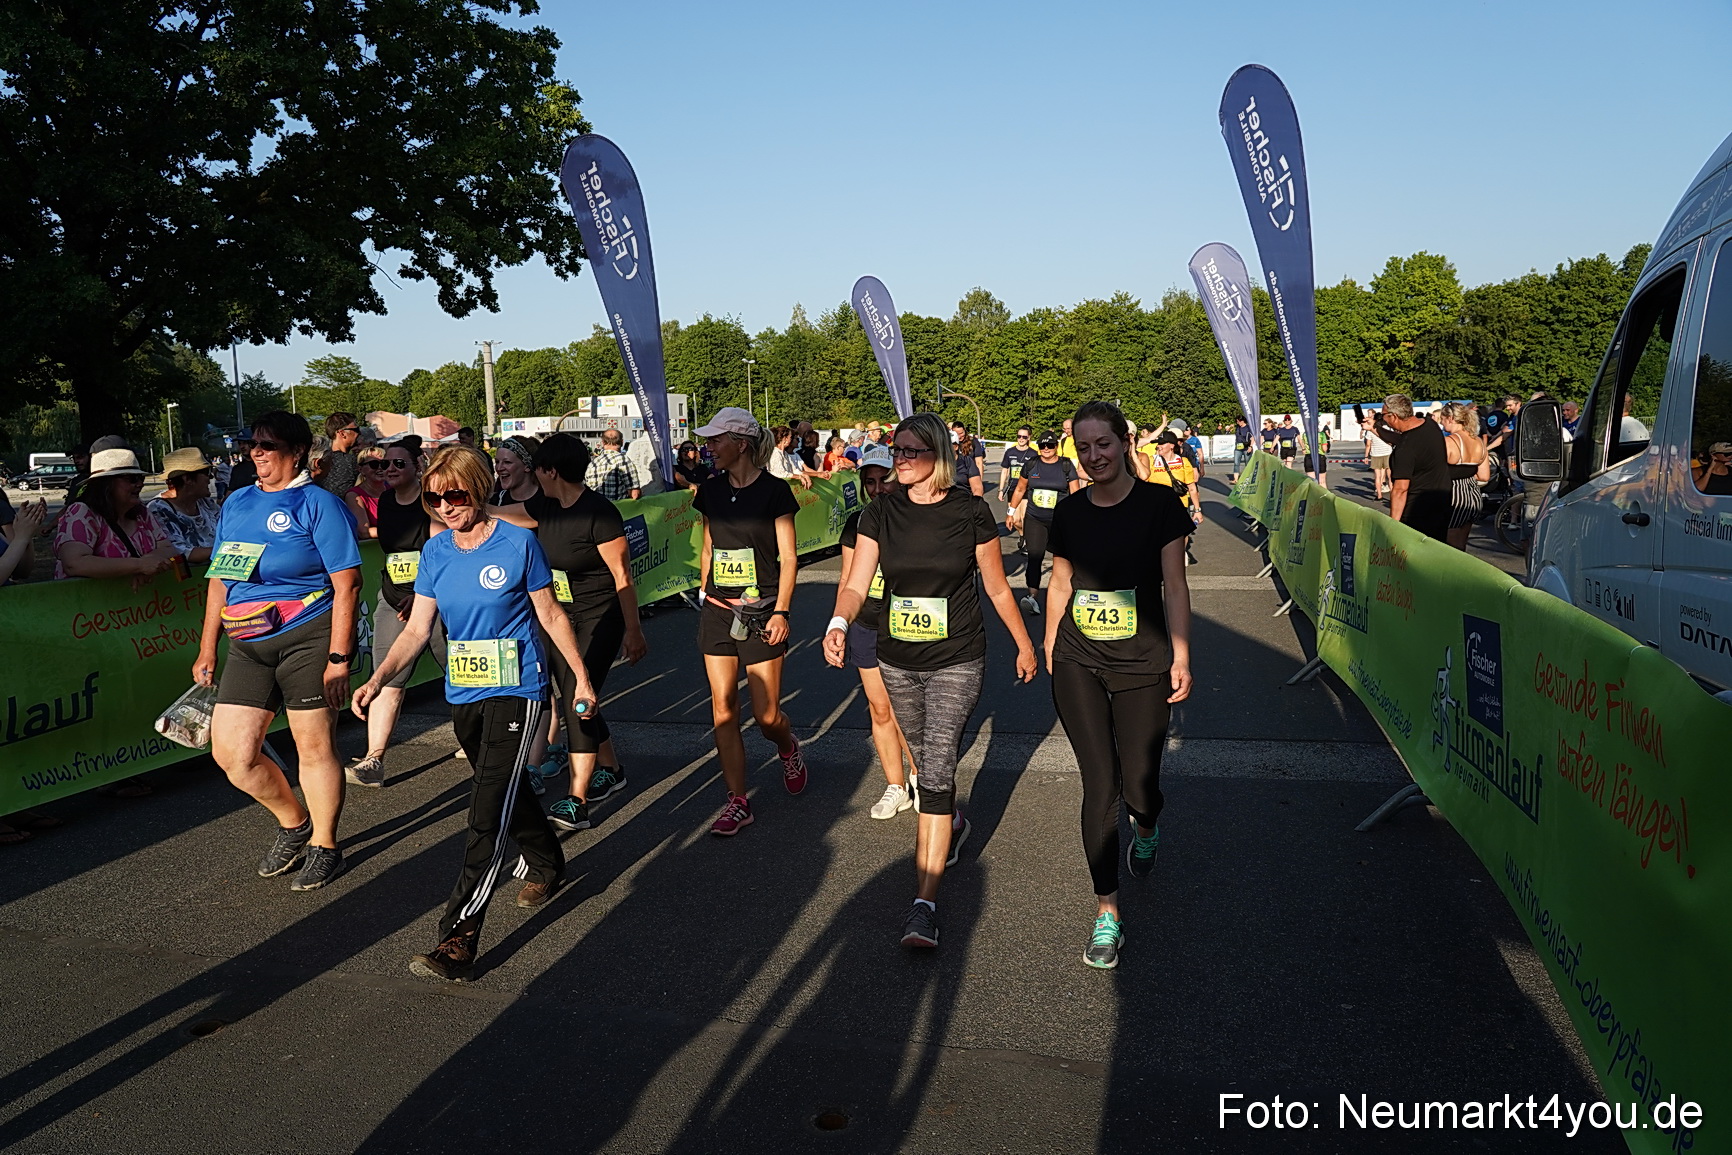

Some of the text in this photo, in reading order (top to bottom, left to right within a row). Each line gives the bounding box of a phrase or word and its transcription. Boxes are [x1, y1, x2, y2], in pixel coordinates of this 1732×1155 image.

[626, 528, 644, 541] Fischer
[1684, 513, 1714, 538] official
[219, 553, 250, 568] 1761
[393, 563, 411, 574] 747
[721, 563, 743, 575] 744
[72, 589, 177, 639] Gesunde
[901, 613, 931, 628] 749
[1087, 608, 1119, 624] 743
[1680, 604, 1712, 627] powered by
[131, 624, 201, 660] laufen
[455, 657, 488, 672] 1758
[1471, 648, 1497, 676] Fischer
[1473, 671, 1495, 687] AUTOMOBILE
[0, 671, 100, 742] lauf
[1534, 652, 1666, 768] Gesunde Firmen
[1455, 699, 1543, 819] firmenlauf
[1454, 761, 1490, 803] neumarkt
[1557, 729, 1696, 879] laufen länger!
